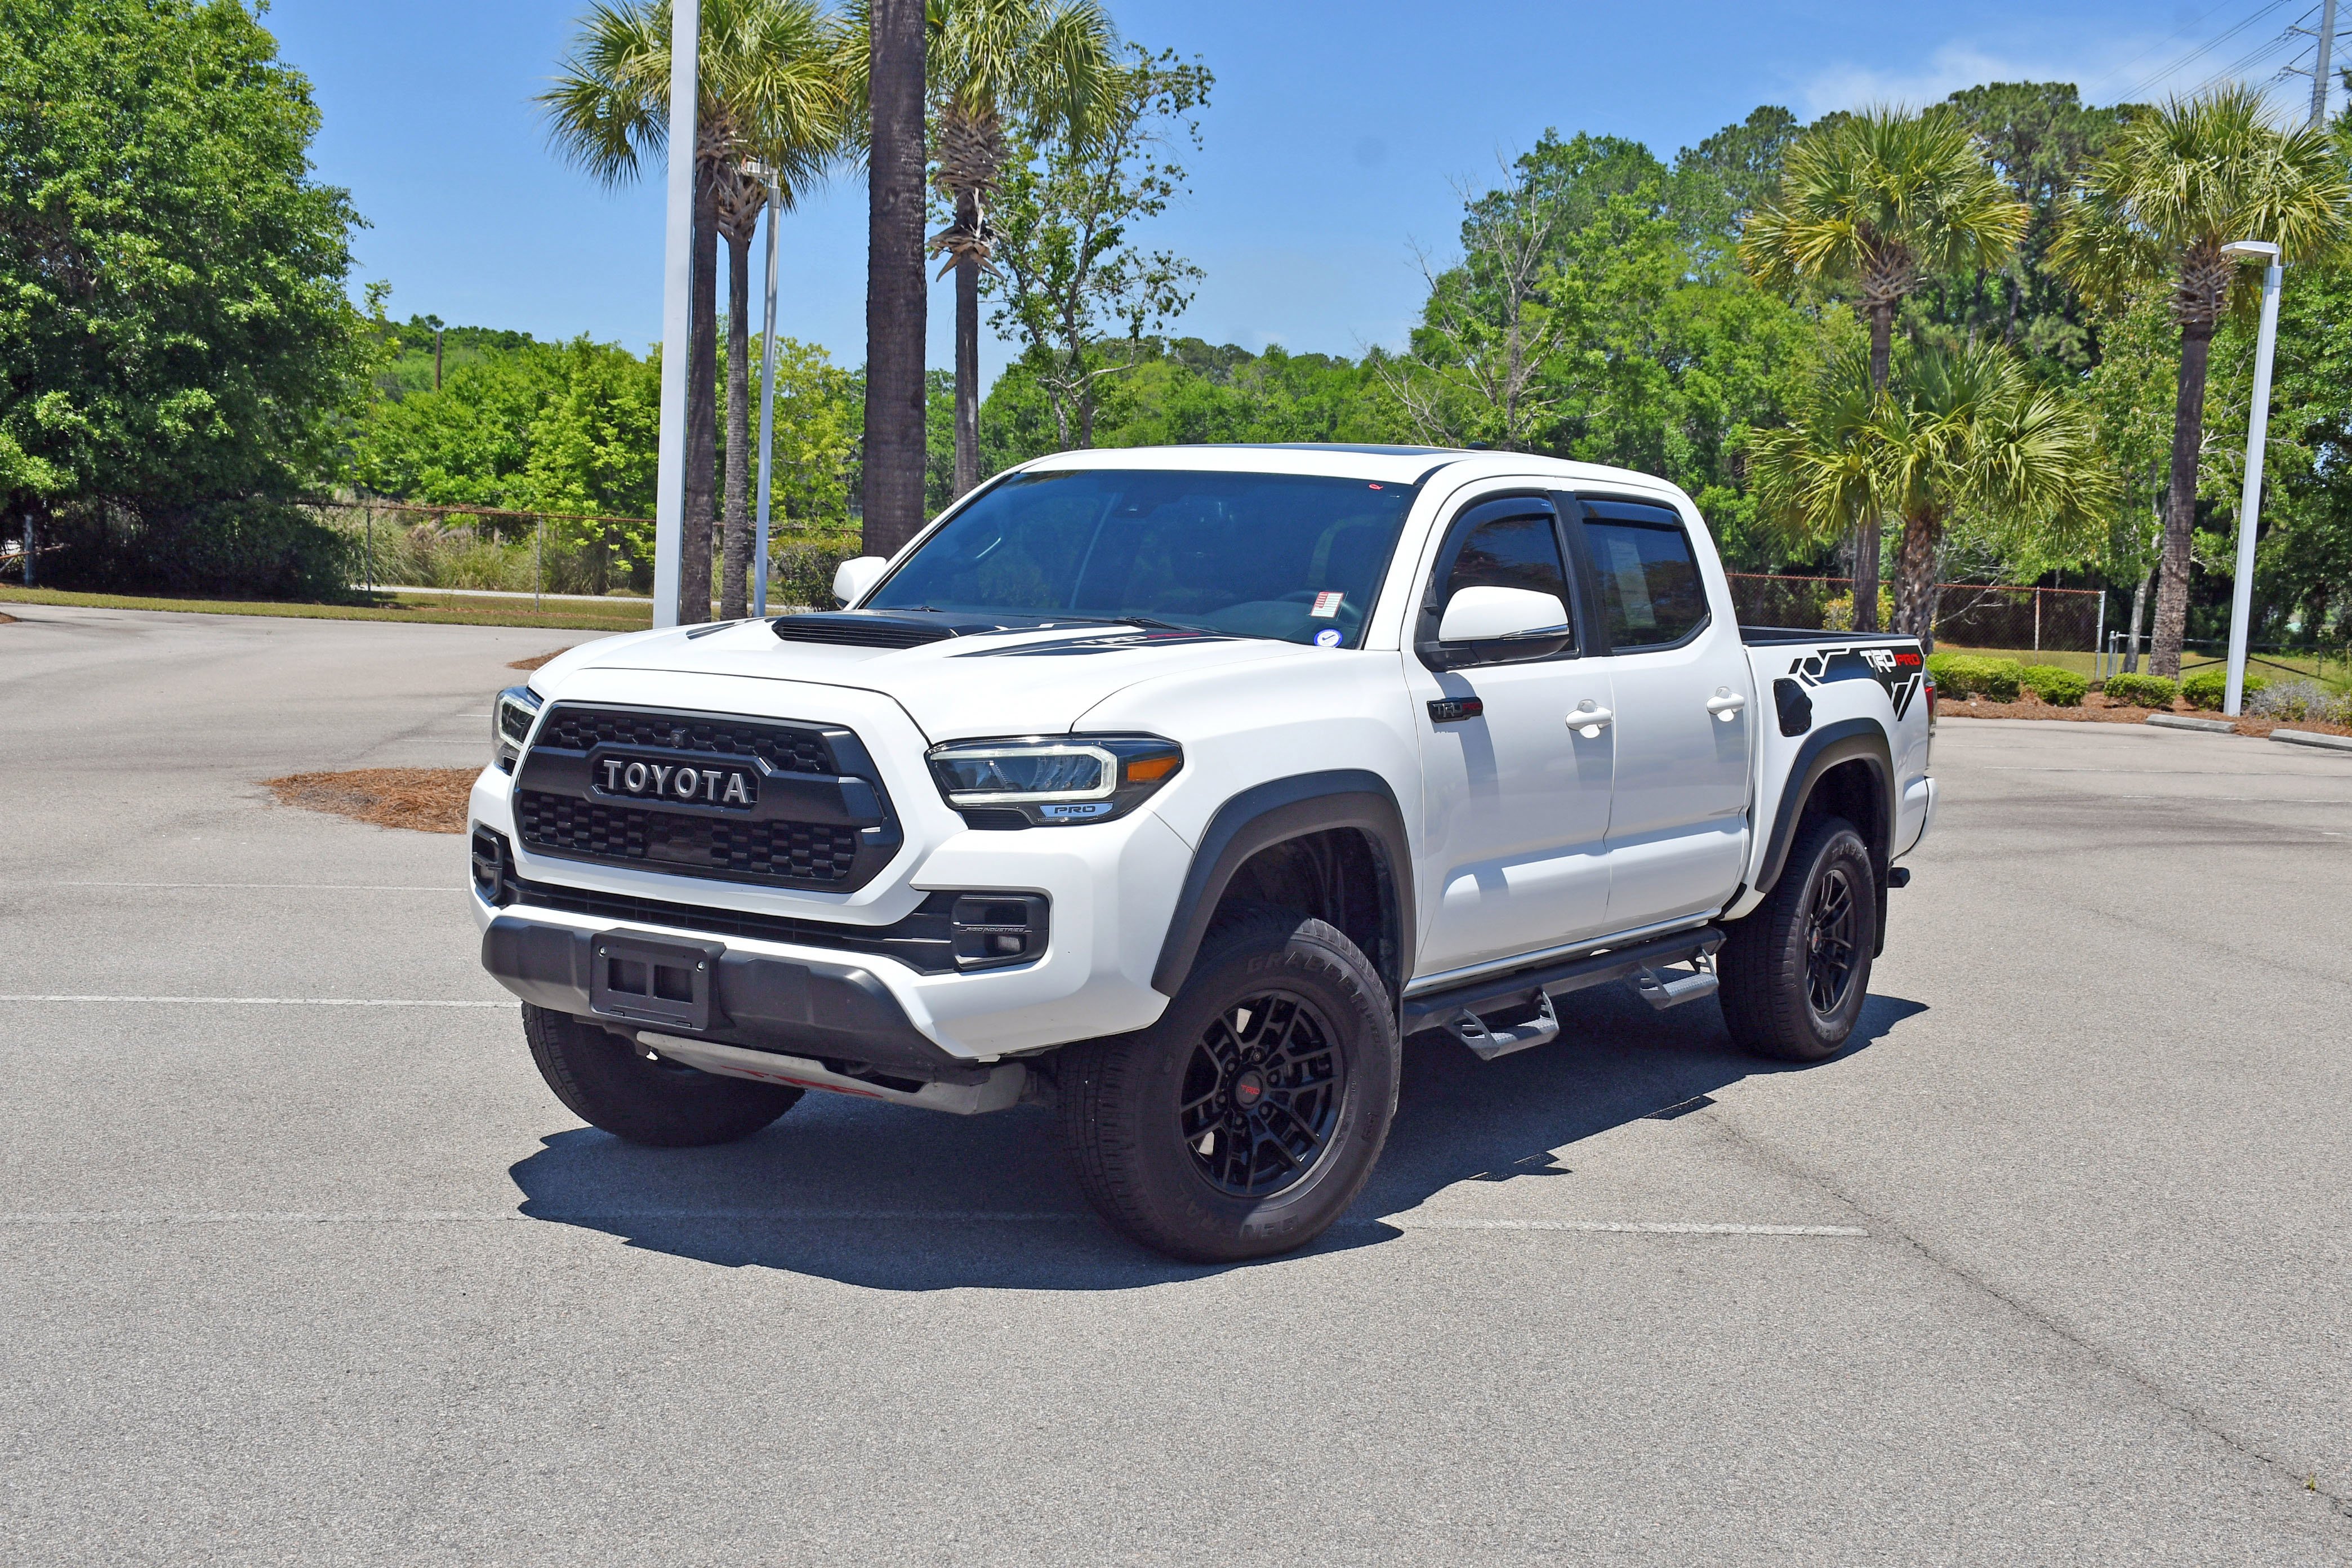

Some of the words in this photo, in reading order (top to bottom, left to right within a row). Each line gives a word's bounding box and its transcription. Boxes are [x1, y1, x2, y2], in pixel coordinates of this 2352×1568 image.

[1071, 635, 1148, 644] TRD
[1859, 649, 1897, 673] TRD
[1895, 653, 1921, 666] PRO
[603, 759, 751, 804] TOYOTA
[1054, 805, 1096, 814] PRO
[1241, 1084, 1260, 1095] TRD
